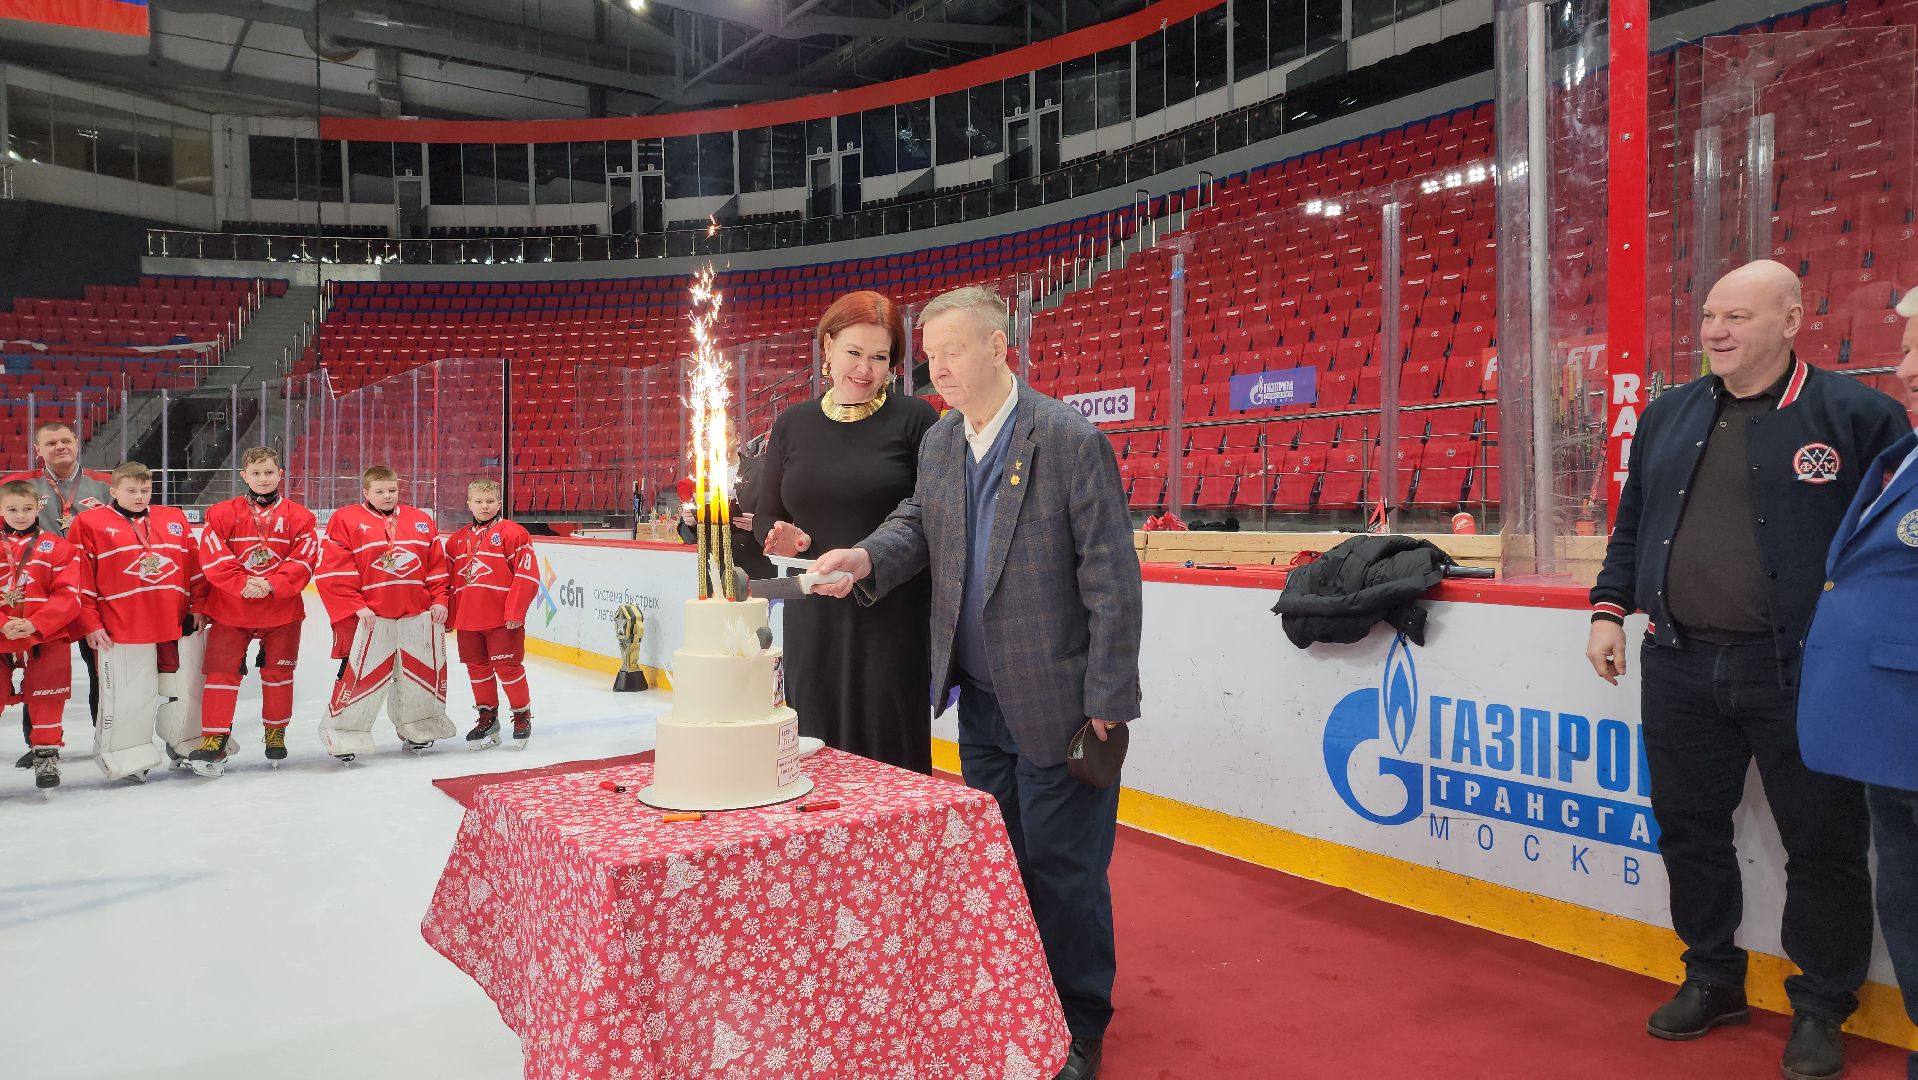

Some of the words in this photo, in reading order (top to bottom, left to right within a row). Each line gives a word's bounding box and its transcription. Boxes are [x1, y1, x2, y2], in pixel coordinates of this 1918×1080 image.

[1800, 461, 1835, 472] ФХМ
[274, 516, 284, 533] A
[204, 530, 223, 554] 11
[559, 578, 584, 609] сбп
[593, 588, 623, 603] система
[624, 588, 660, 610] быстрых
[594, 608, 616, 622] плате
[1436, 775, 1651, 844] ТРАНСГА
[1430, 813, 1640, 885] МОСКВ
